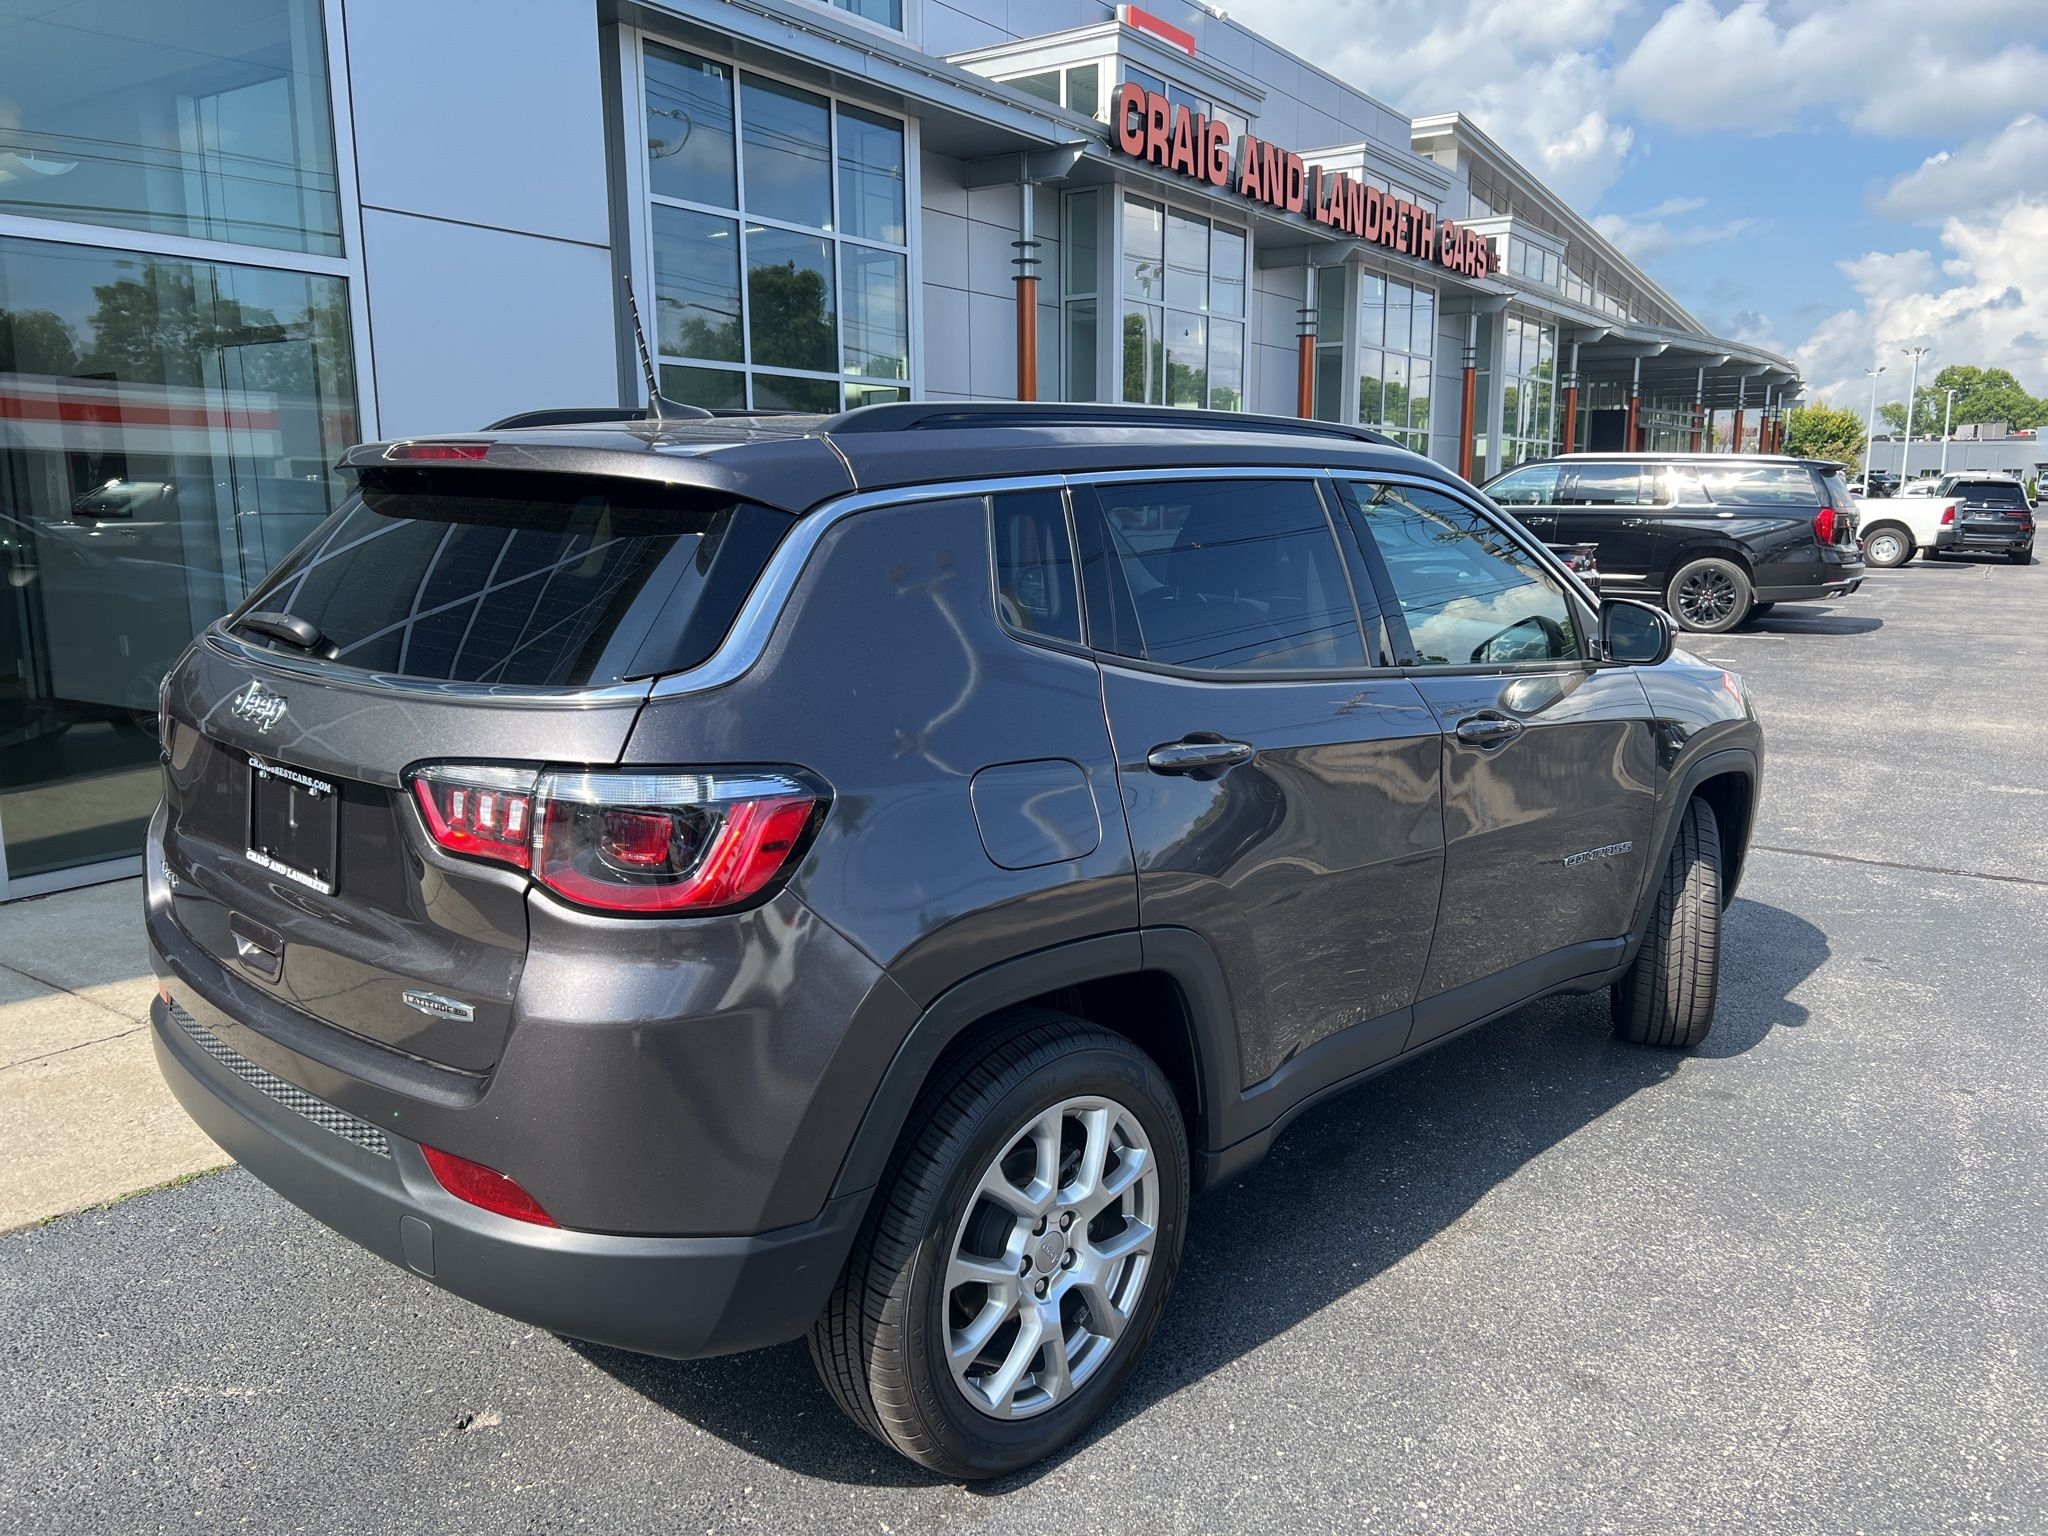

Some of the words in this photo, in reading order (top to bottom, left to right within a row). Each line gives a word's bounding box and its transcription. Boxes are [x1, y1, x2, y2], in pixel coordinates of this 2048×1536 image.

[1113, 82, 1230, 187] CRAIG
[1238, 134, 1305, 214] AND
[1312, 165, 1436, 261] LANDRETH
[1440, 219, 1487, 279] CARS
[231, 680, 288, 735] Jeep
[1563, 841, 1633, 867] COMPASS
